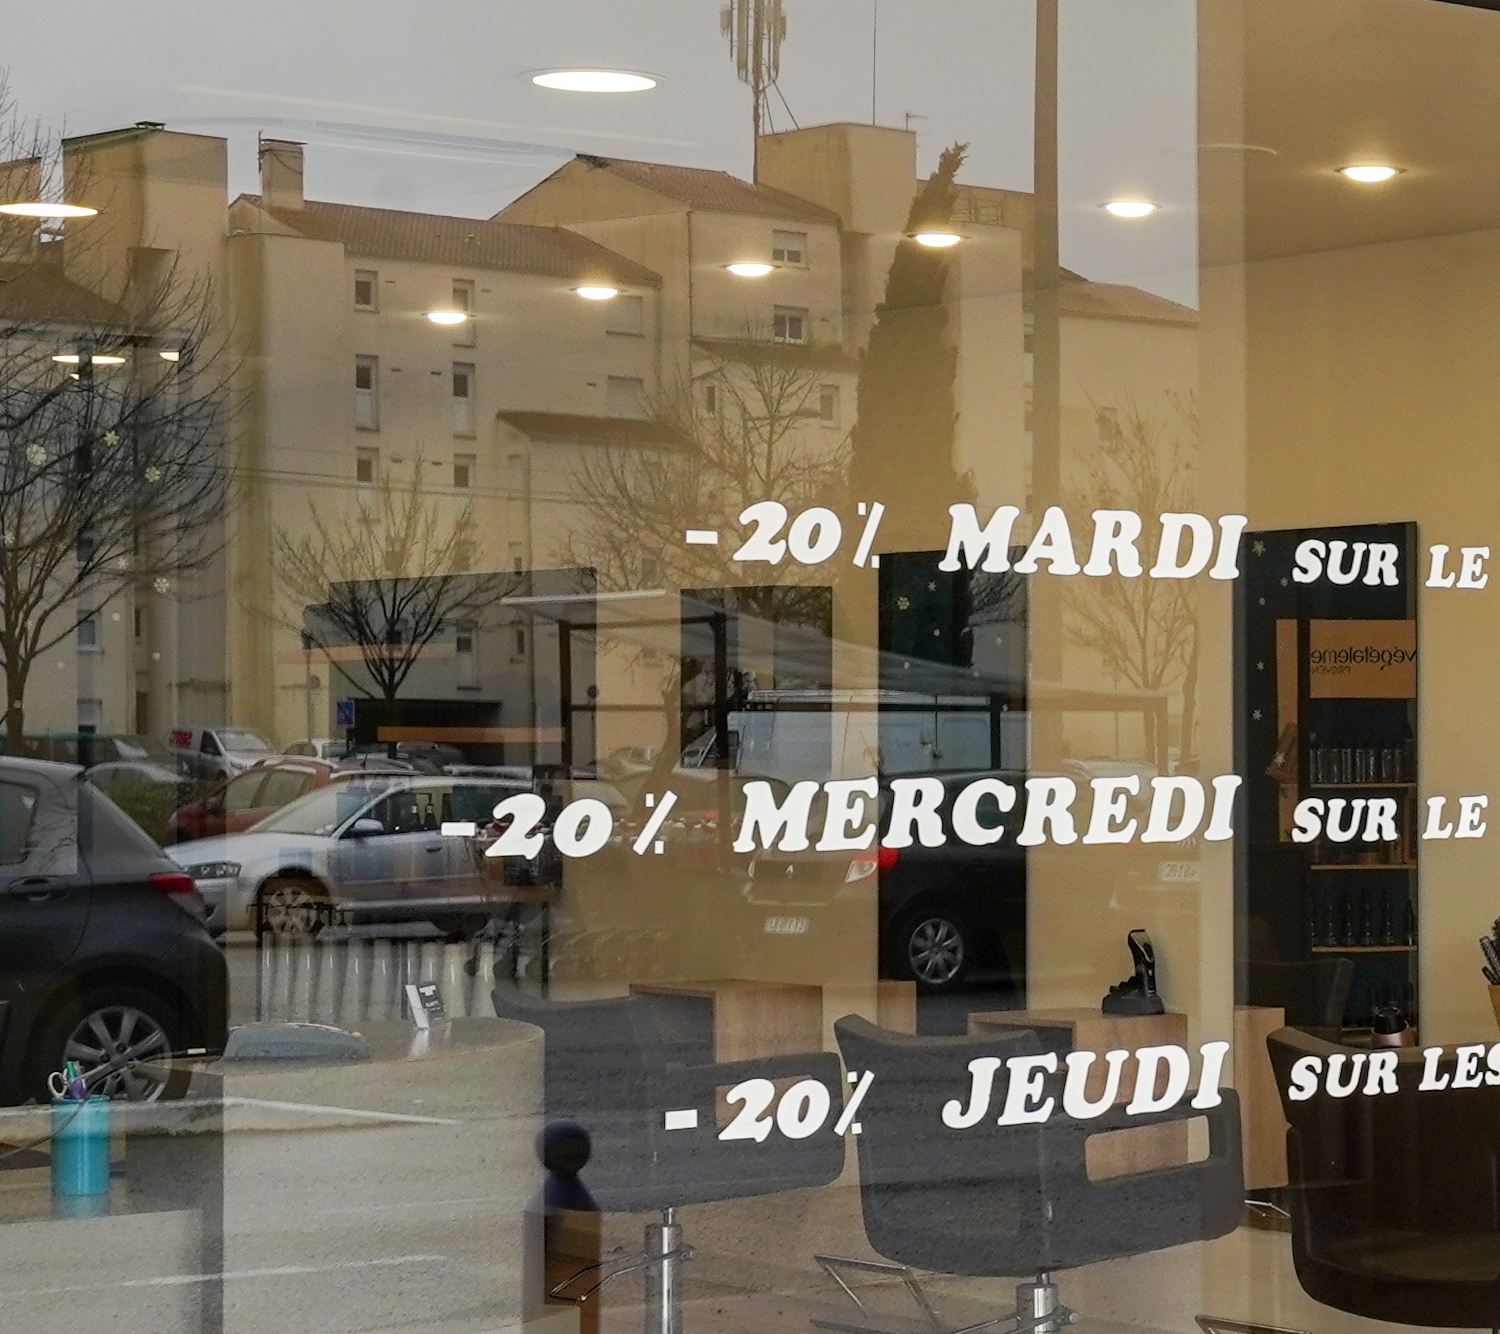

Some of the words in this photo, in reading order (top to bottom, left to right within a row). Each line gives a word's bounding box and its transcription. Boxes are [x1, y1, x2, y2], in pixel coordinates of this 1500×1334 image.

[938, 503, 1248, 580] MARDI
[1292, 539, 1399, 587] SUR
[1426, 543, 1490, 590] LE
[732, 774, 1242, 855] MERCREDI
[1292, 796, 1398, 843] SUR
[1423, 795, 1489, 840] LE
[943, 1039, 1232, 1134] JEUDI
[1288, 1049, 1400, 1100] SUR
